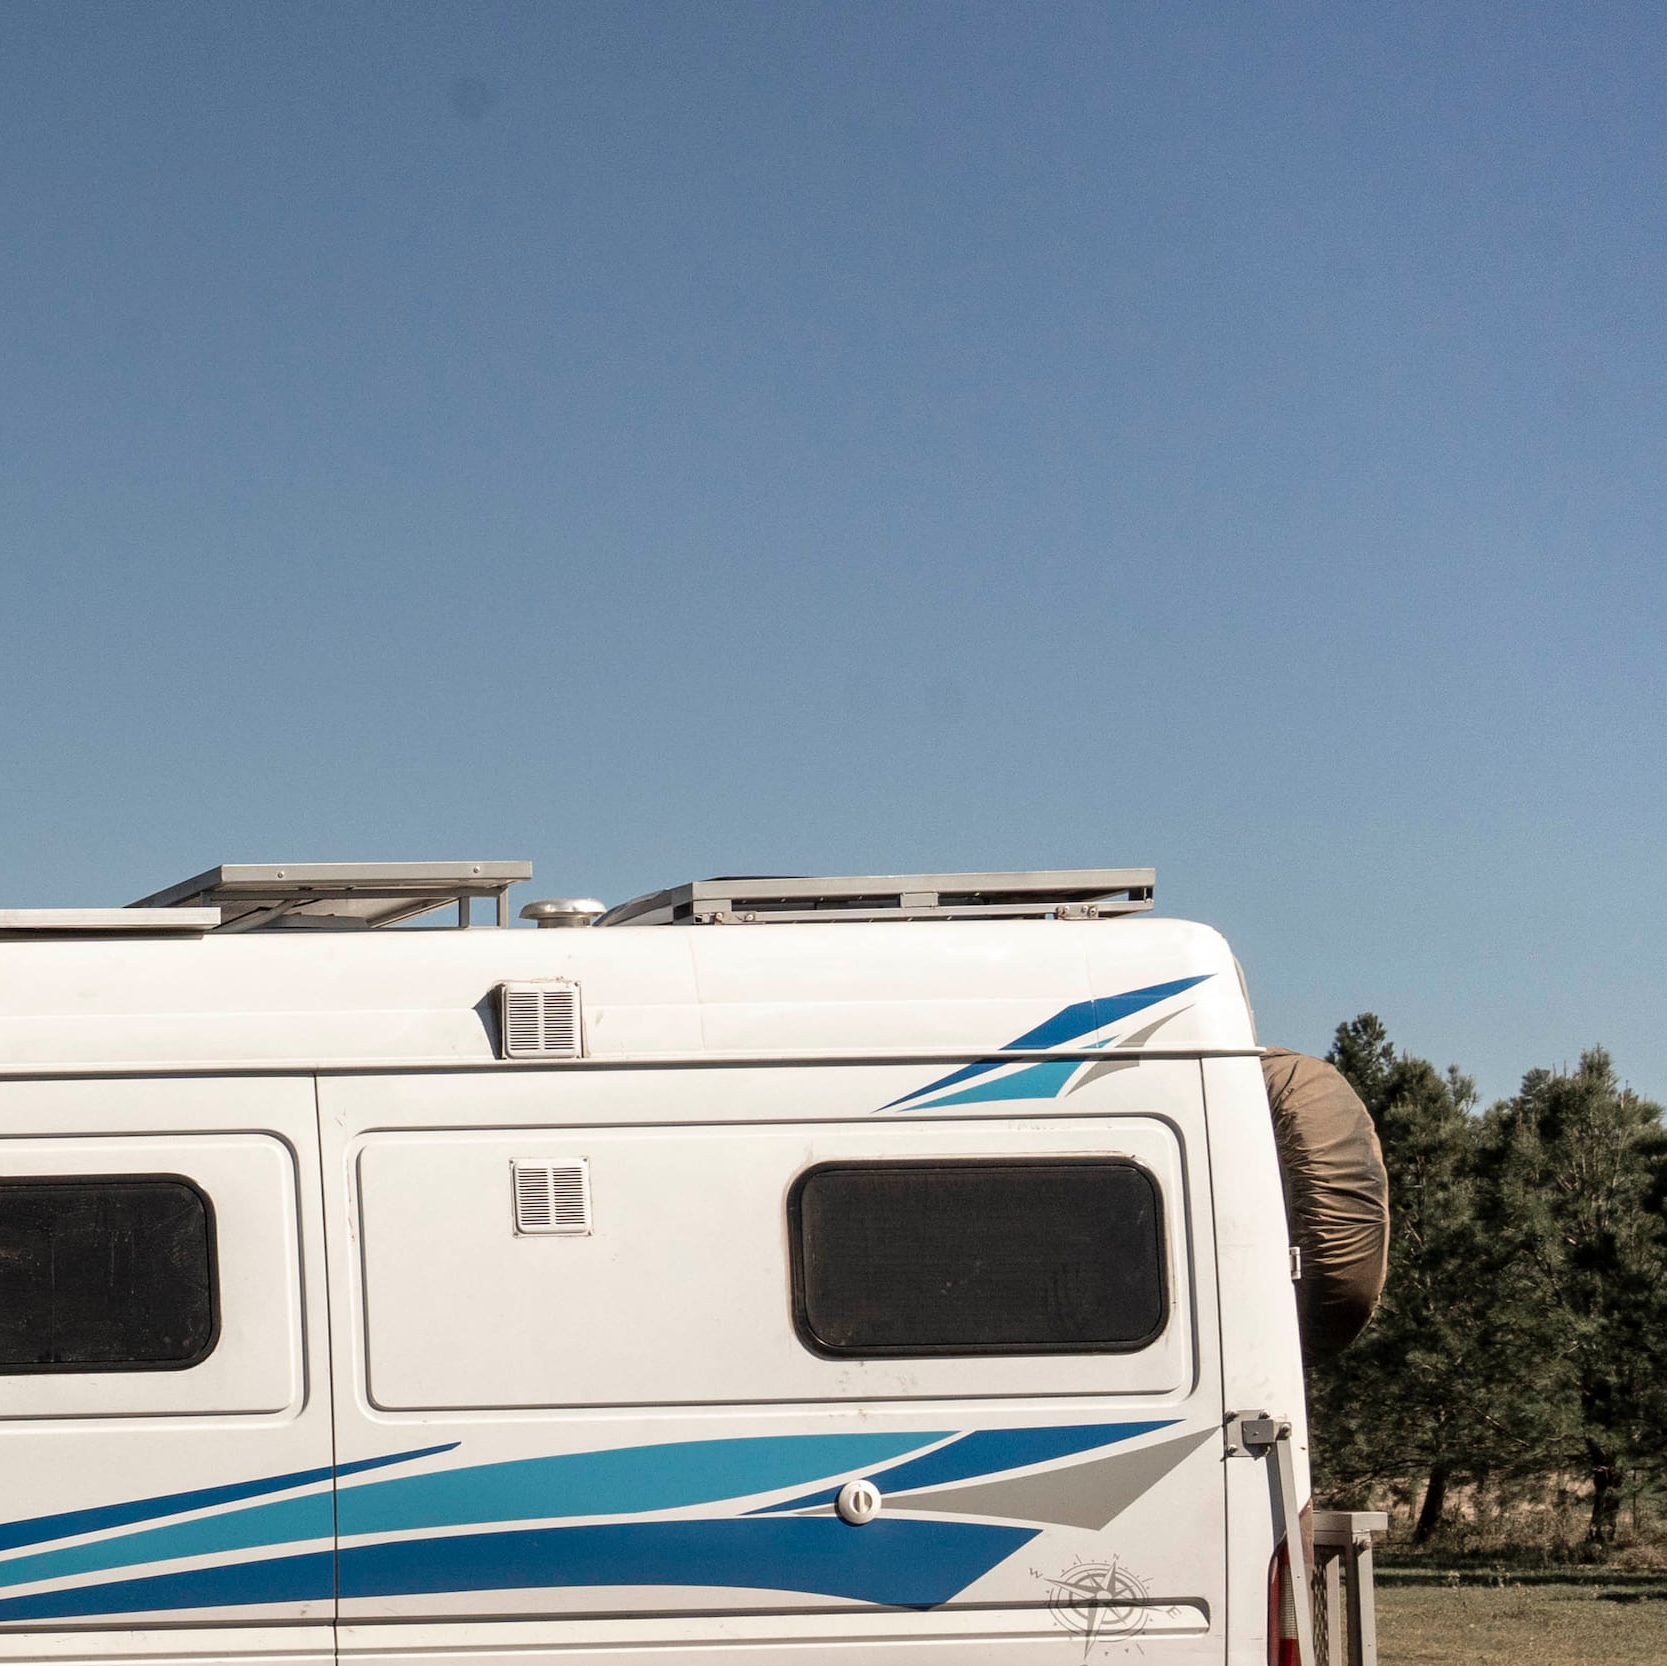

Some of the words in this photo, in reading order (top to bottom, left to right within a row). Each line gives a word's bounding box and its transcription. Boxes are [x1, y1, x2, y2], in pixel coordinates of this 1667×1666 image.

[1112, 1552, 1121, 1561] N
[1029, 1567, 1044, 1579] W
[1166, 1606, 1182, 1619] E
